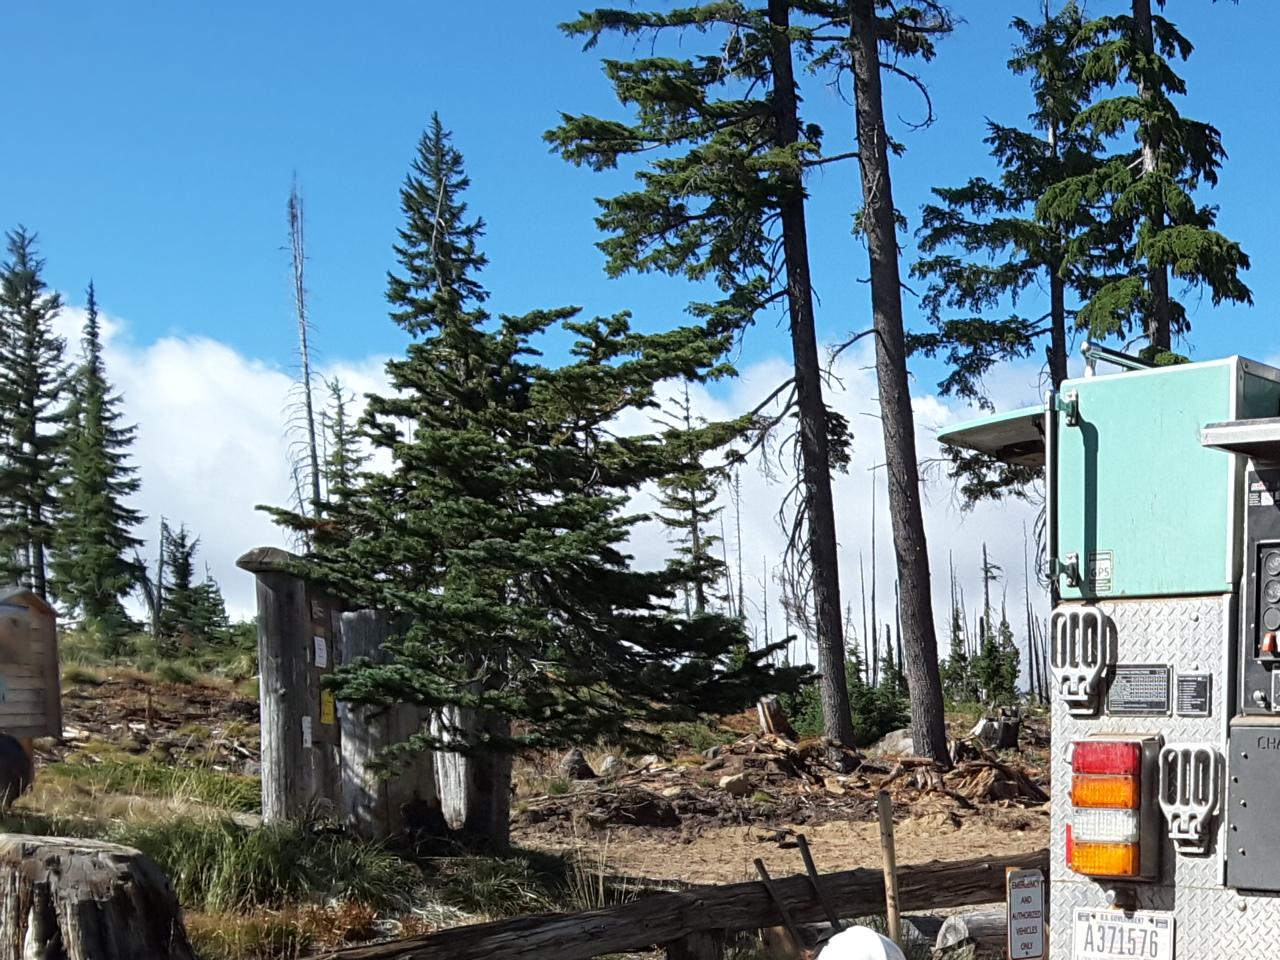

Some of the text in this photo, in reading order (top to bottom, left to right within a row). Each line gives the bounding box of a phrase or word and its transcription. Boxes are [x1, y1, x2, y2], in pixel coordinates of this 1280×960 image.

[1011, 880, 1040, 890] EMERGENCY
[1020, 896, 1032, 905] AND
[1012, 910, 1041, 920] AUTHORIZED
[1016, 926, 1038, 935] VEHICLES
[1084, 924, 1158, 958] A371576
[1020, 942, 1033, 951] ONLY
